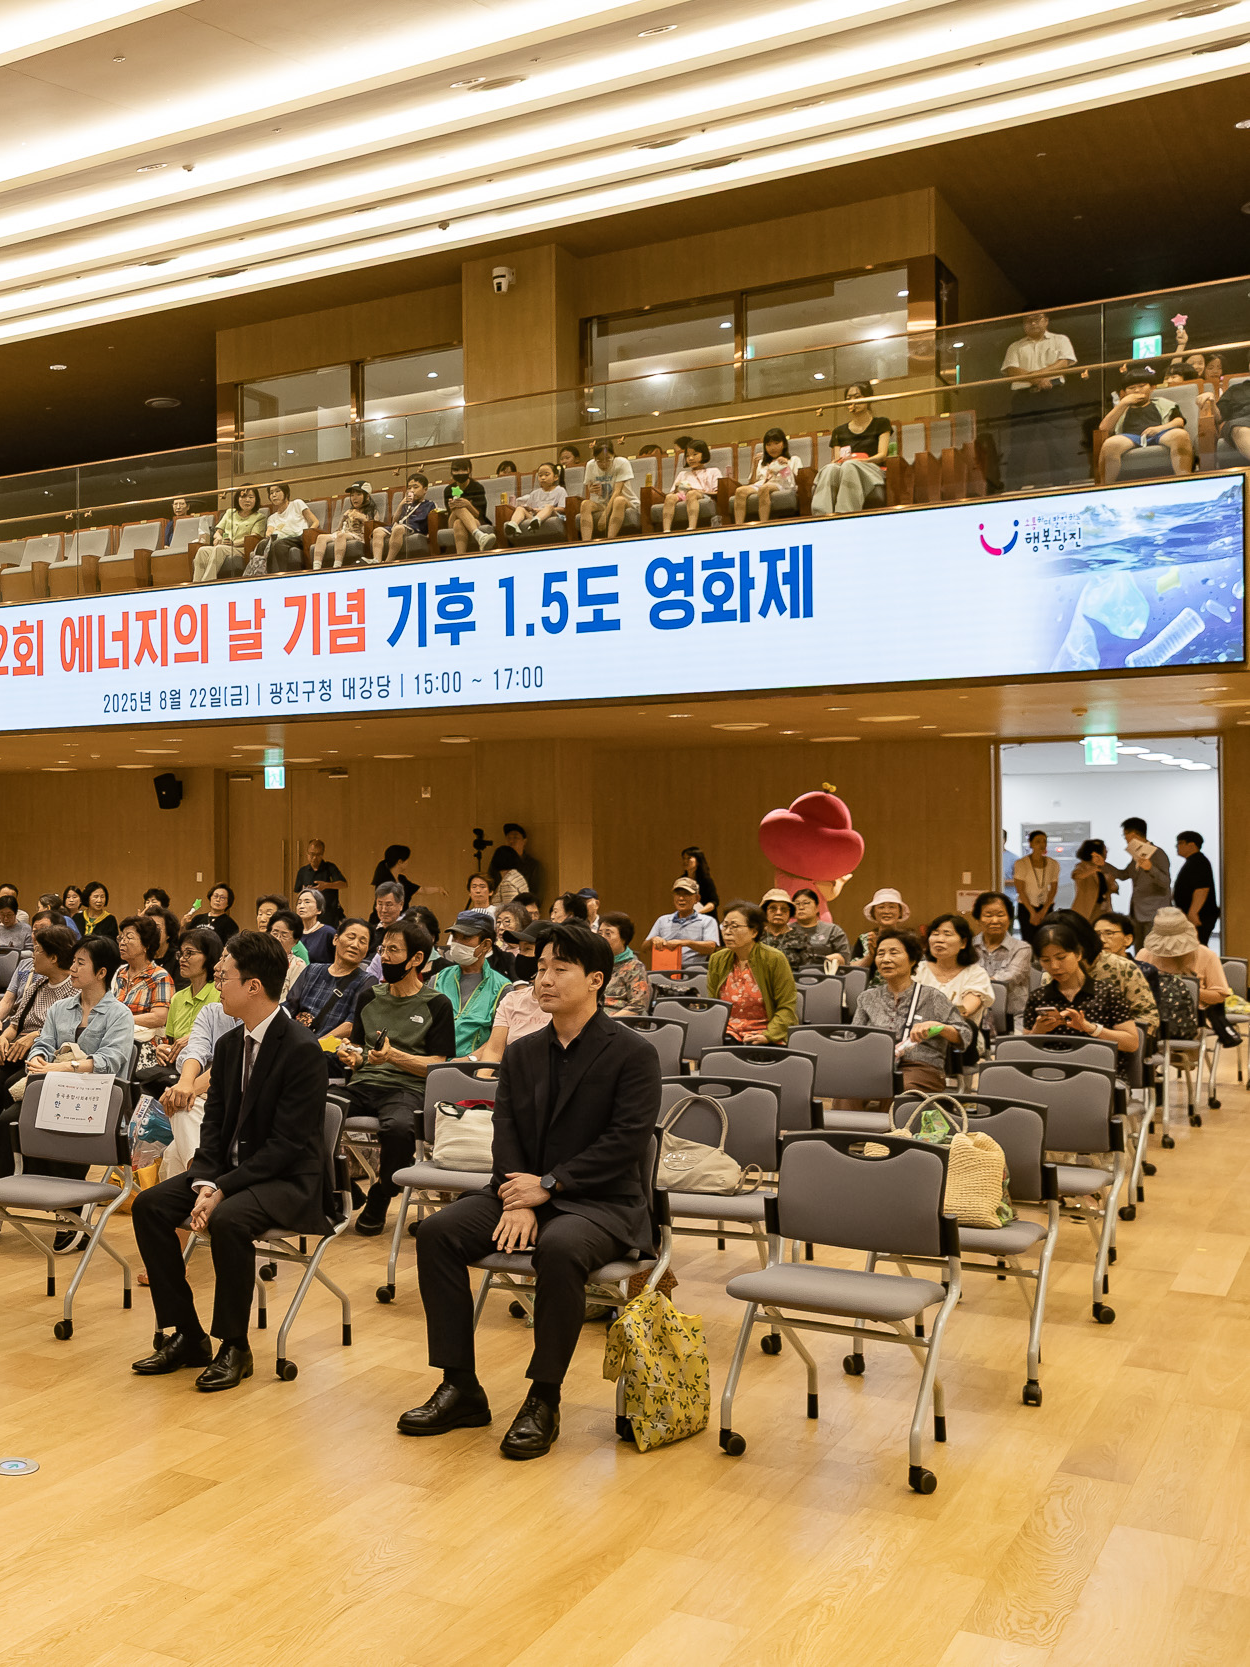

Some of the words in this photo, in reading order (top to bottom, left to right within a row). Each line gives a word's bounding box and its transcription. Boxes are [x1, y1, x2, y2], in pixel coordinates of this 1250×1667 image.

[1024, 527, 1081, 553] 행복광진
[59, 603, 209, 673] 에너지의
[228, 597, 266, 662] 날
[282, 587, 366, 656] 기념
[386, 576, 476, 648] 기후
[497, 563, 622, 637] 1.5도
[643, 543, 814, 631] 영화제
[103, 690, 152, 714] 2025년
[159, 687, 181, 710] 8월
[189, 683, 249, 709] 22일(금)
[269, 678, 332, 705] 광진구청
[342, 674, 391, 700] 대강당
[414, 670, 462, 695] 15:00
[493, 665, 544, 691] 17:00
